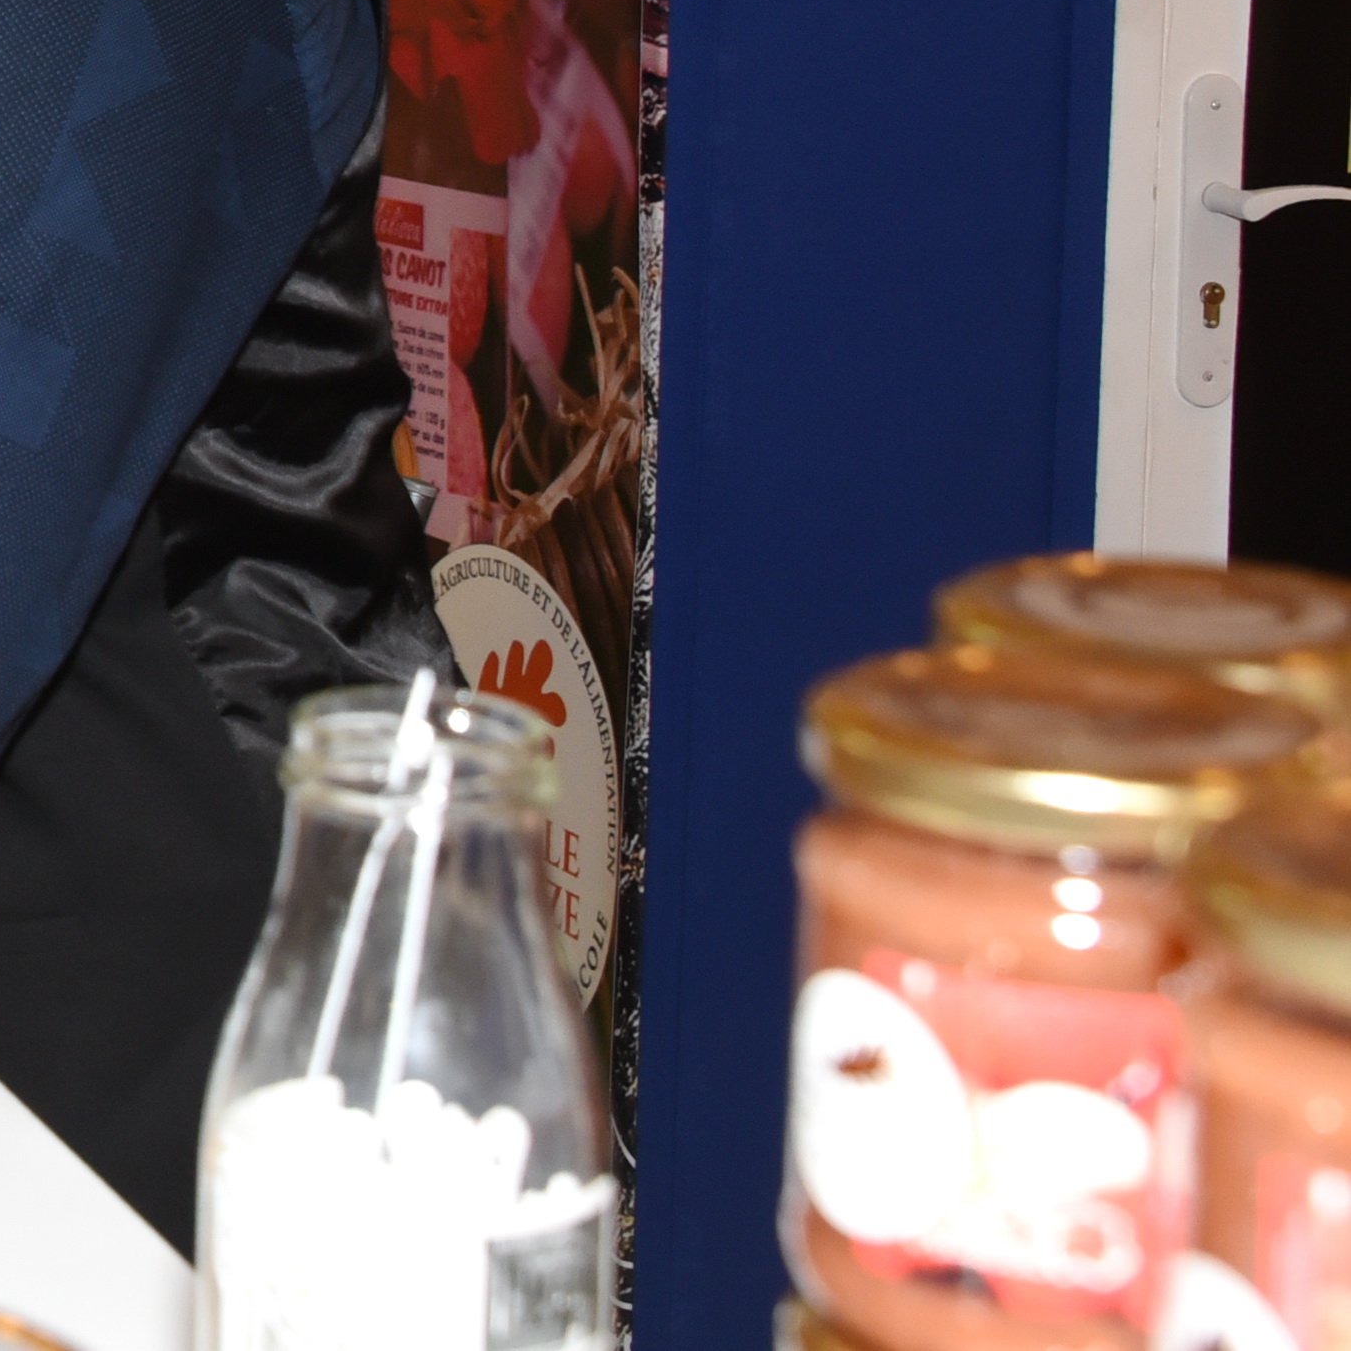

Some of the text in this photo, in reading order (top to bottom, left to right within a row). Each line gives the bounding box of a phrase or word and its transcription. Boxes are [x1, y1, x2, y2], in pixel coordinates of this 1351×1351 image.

[397, 252, 447, 289] CANOT
[416, 294, 449, 318] EXTRA
[532, 583, 552, 613] ET
[550, 608, 573, 644] DE
[569, 638, 618, 876] L'ALIMENTATION
